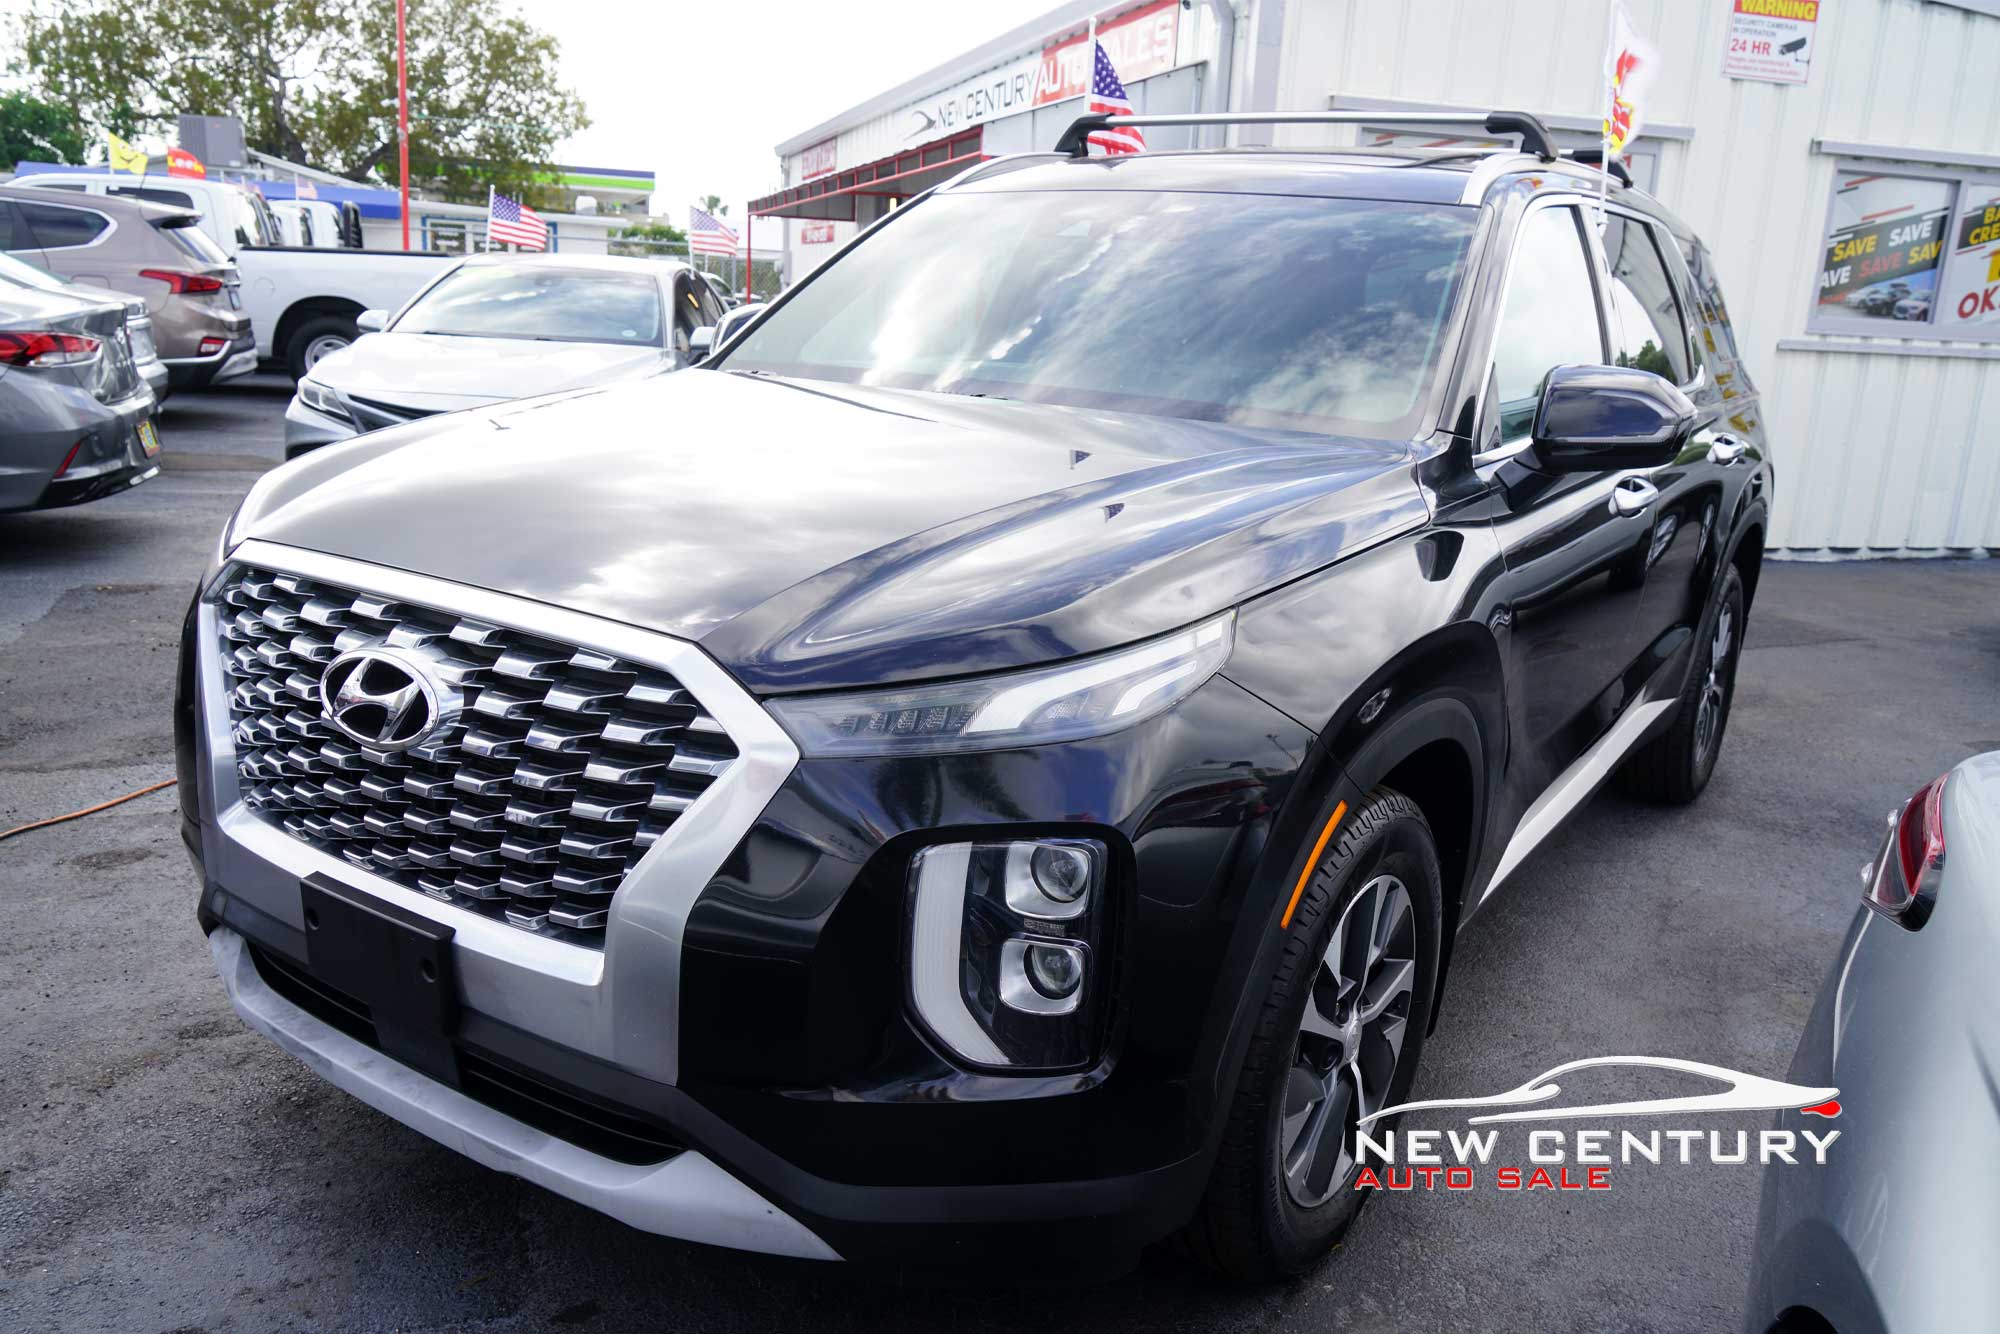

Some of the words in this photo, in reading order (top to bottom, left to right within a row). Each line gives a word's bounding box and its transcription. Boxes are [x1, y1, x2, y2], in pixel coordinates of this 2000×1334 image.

[1741, 0, 1817, 21] WARNING
[1730, 38, 1747, 53] 24
[1751, 40, 1771, 56] HR
[966, 69, 1036, 120] CENTURY
[1832, 234, 1878, 262] SAVE
[1889, 220, 1933, 247] SAVE
[1858, 253, 1904, 279] SAVE
